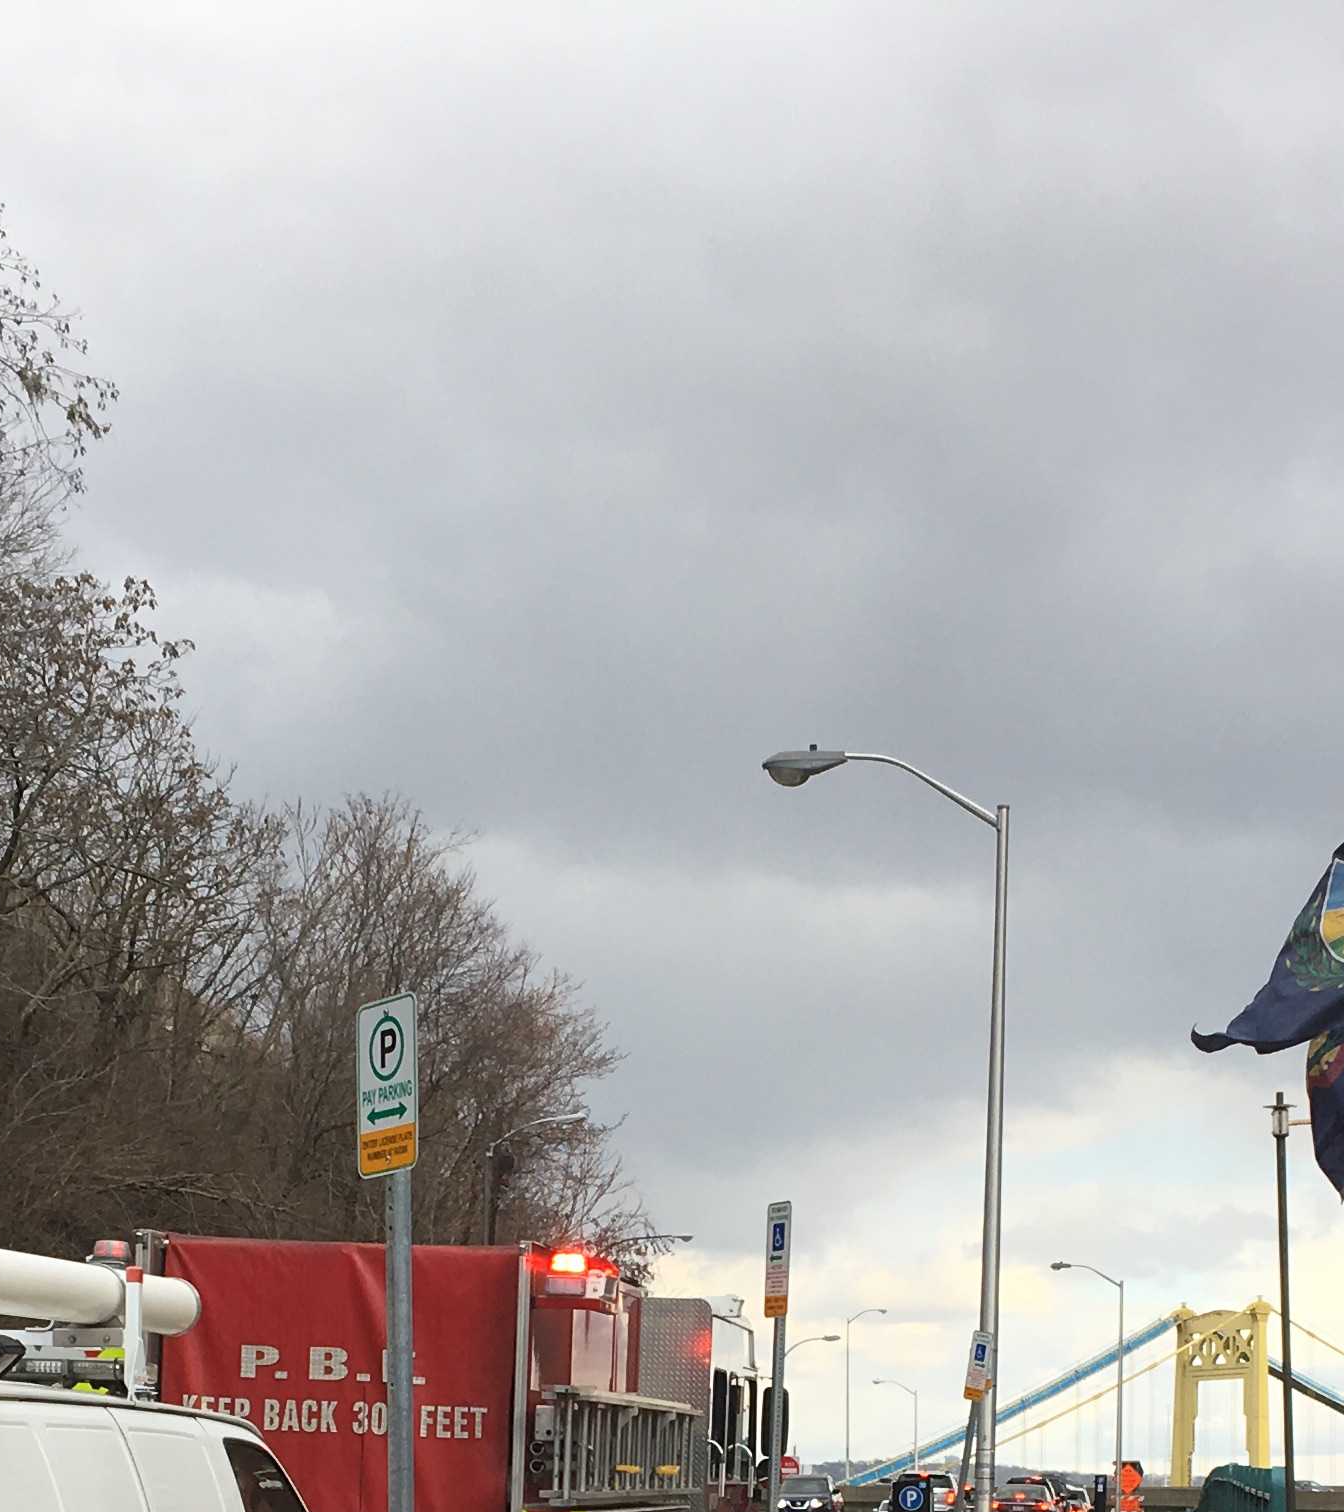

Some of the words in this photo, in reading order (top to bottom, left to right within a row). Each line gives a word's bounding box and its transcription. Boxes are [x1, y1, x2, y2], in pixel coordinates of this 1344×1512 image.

[380, 1028, 396, 1068] P
[362, 1087, 377, 1107] PAY
[378, 1080, 413, 1104] PARKING
[263, 1399, 338, 1433] BACK
[420, 1404, 488, 1439] FEET
